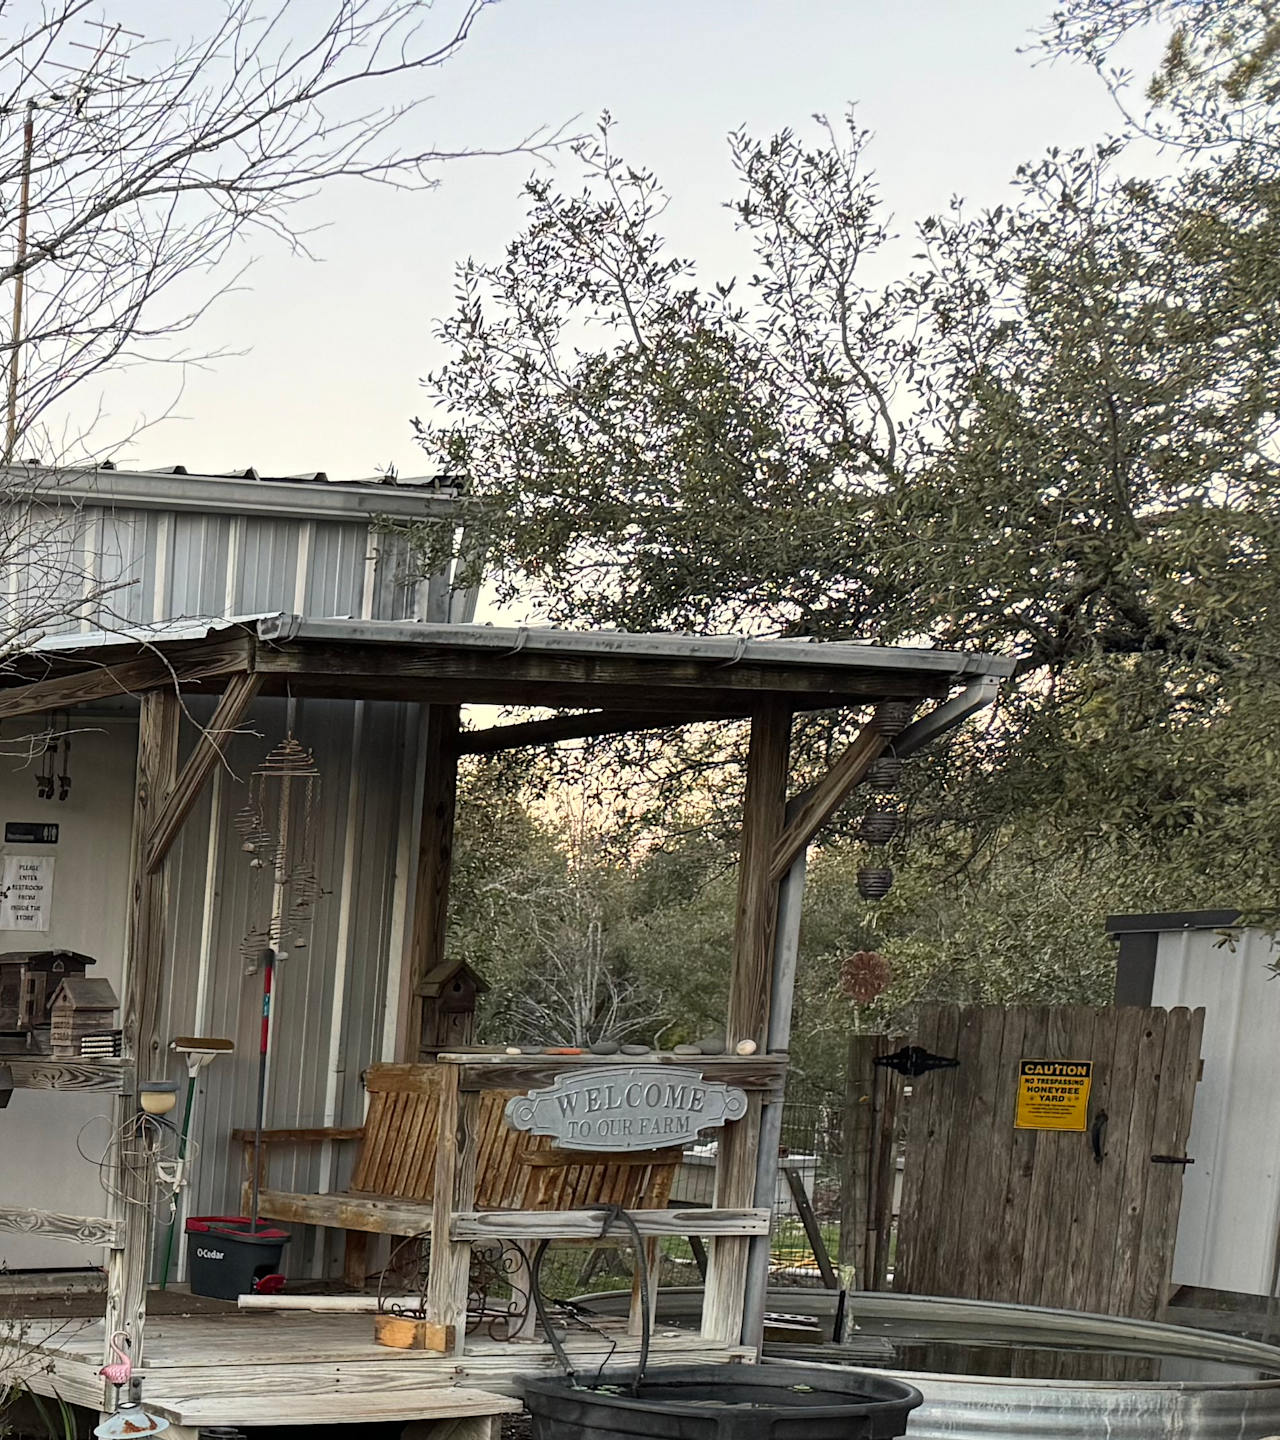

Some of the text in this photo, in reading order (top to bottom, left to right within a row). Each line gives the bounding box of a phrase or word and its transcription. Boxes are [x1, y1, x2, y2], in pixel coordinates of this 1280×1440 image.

[1025, 1064, 1087, 1075] CAUTION
[1027, 1086, 1080, 1094] HONEYBEE
[554, 1082, 706, 1118] WELCOME
[568, 1116, 690, 1138] TO OUR FARM
